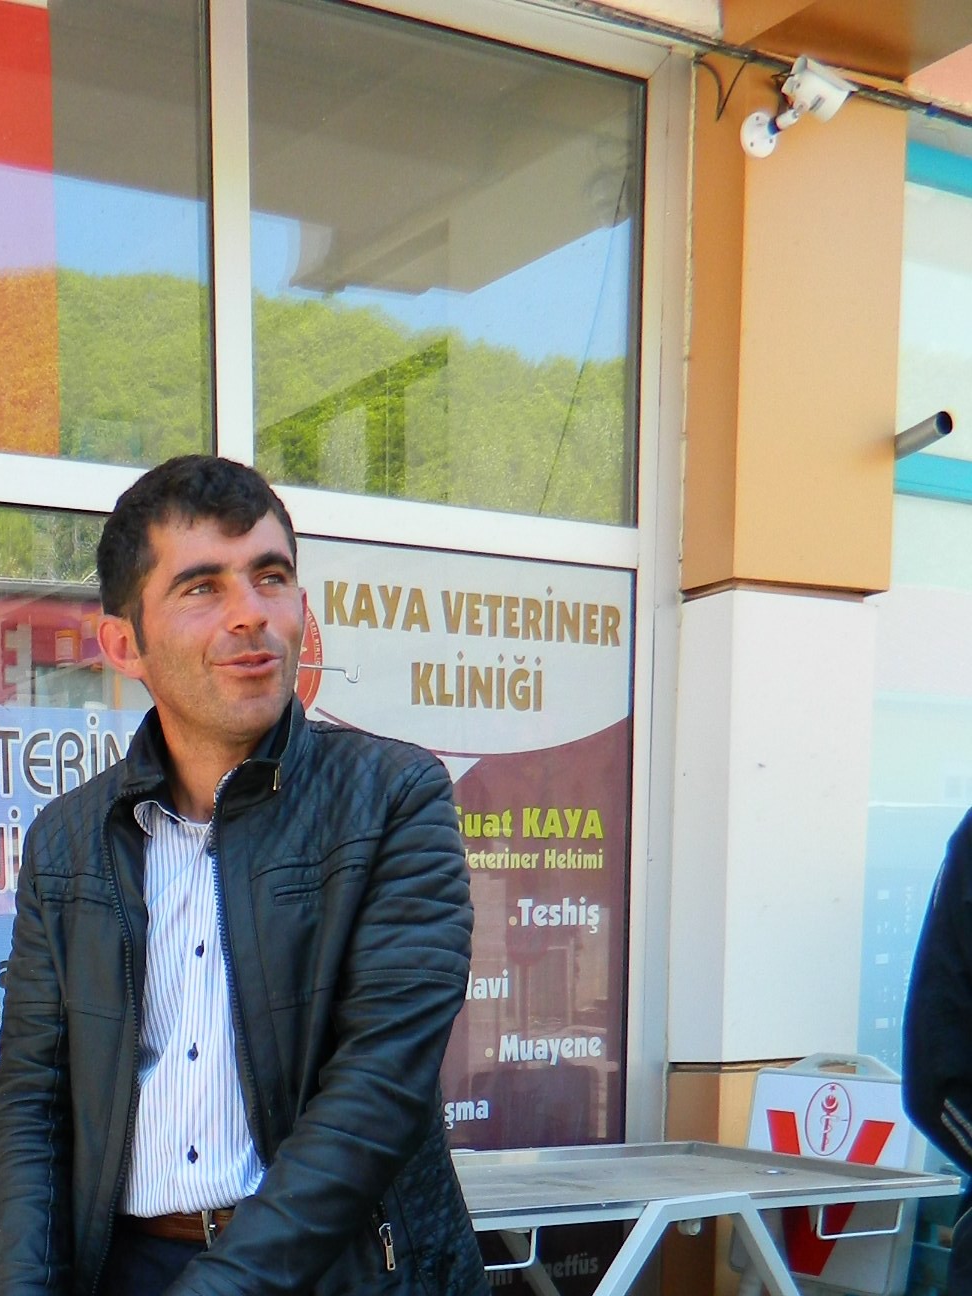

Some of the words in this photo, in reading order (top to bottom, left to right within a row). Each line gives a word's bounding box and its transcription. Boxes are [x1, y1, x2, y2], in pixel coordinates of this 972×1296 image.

[324, 580, 430, 633] KAYA
[440, 585, 621, 648] VETERİNER
[411, 650, 543, 712] KLİNİĞİ
[522, 807, 604, 839] KAYA
[465, 847, 539, 869] eteriner
[544, 848, 603, 869] Hekimi
[517, 896, 600, 934] Teshiş
[498, 1034, 602, 1066] Muayene
[443, 1100, 489, 1130] şma
